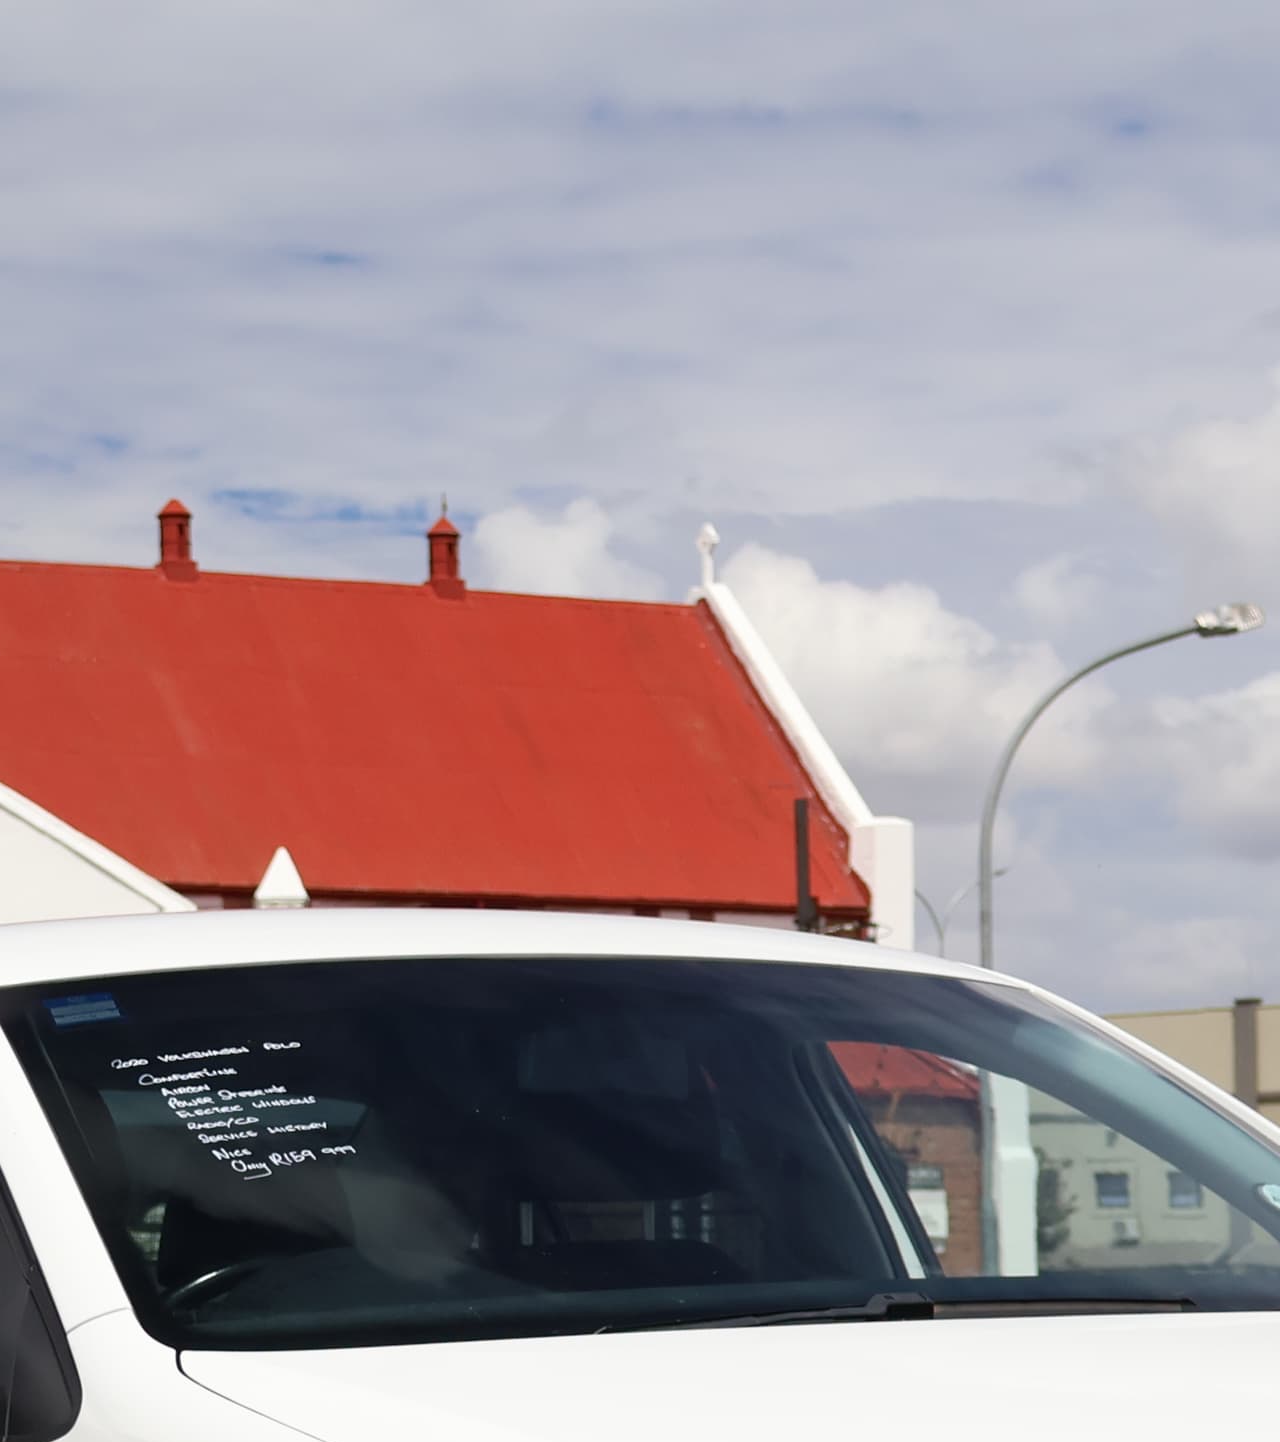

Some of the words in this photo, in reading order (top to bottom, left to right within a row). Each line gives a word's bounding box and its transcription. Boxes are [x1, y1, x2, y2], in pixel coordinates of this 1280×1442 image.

[111, 1058, 149, 1069] 2020
[168, 1096, 215, 1110] POWER
[175, 1104, 244, 1119] ELECTRIC
[269, 1149, 317, 1167] R159
